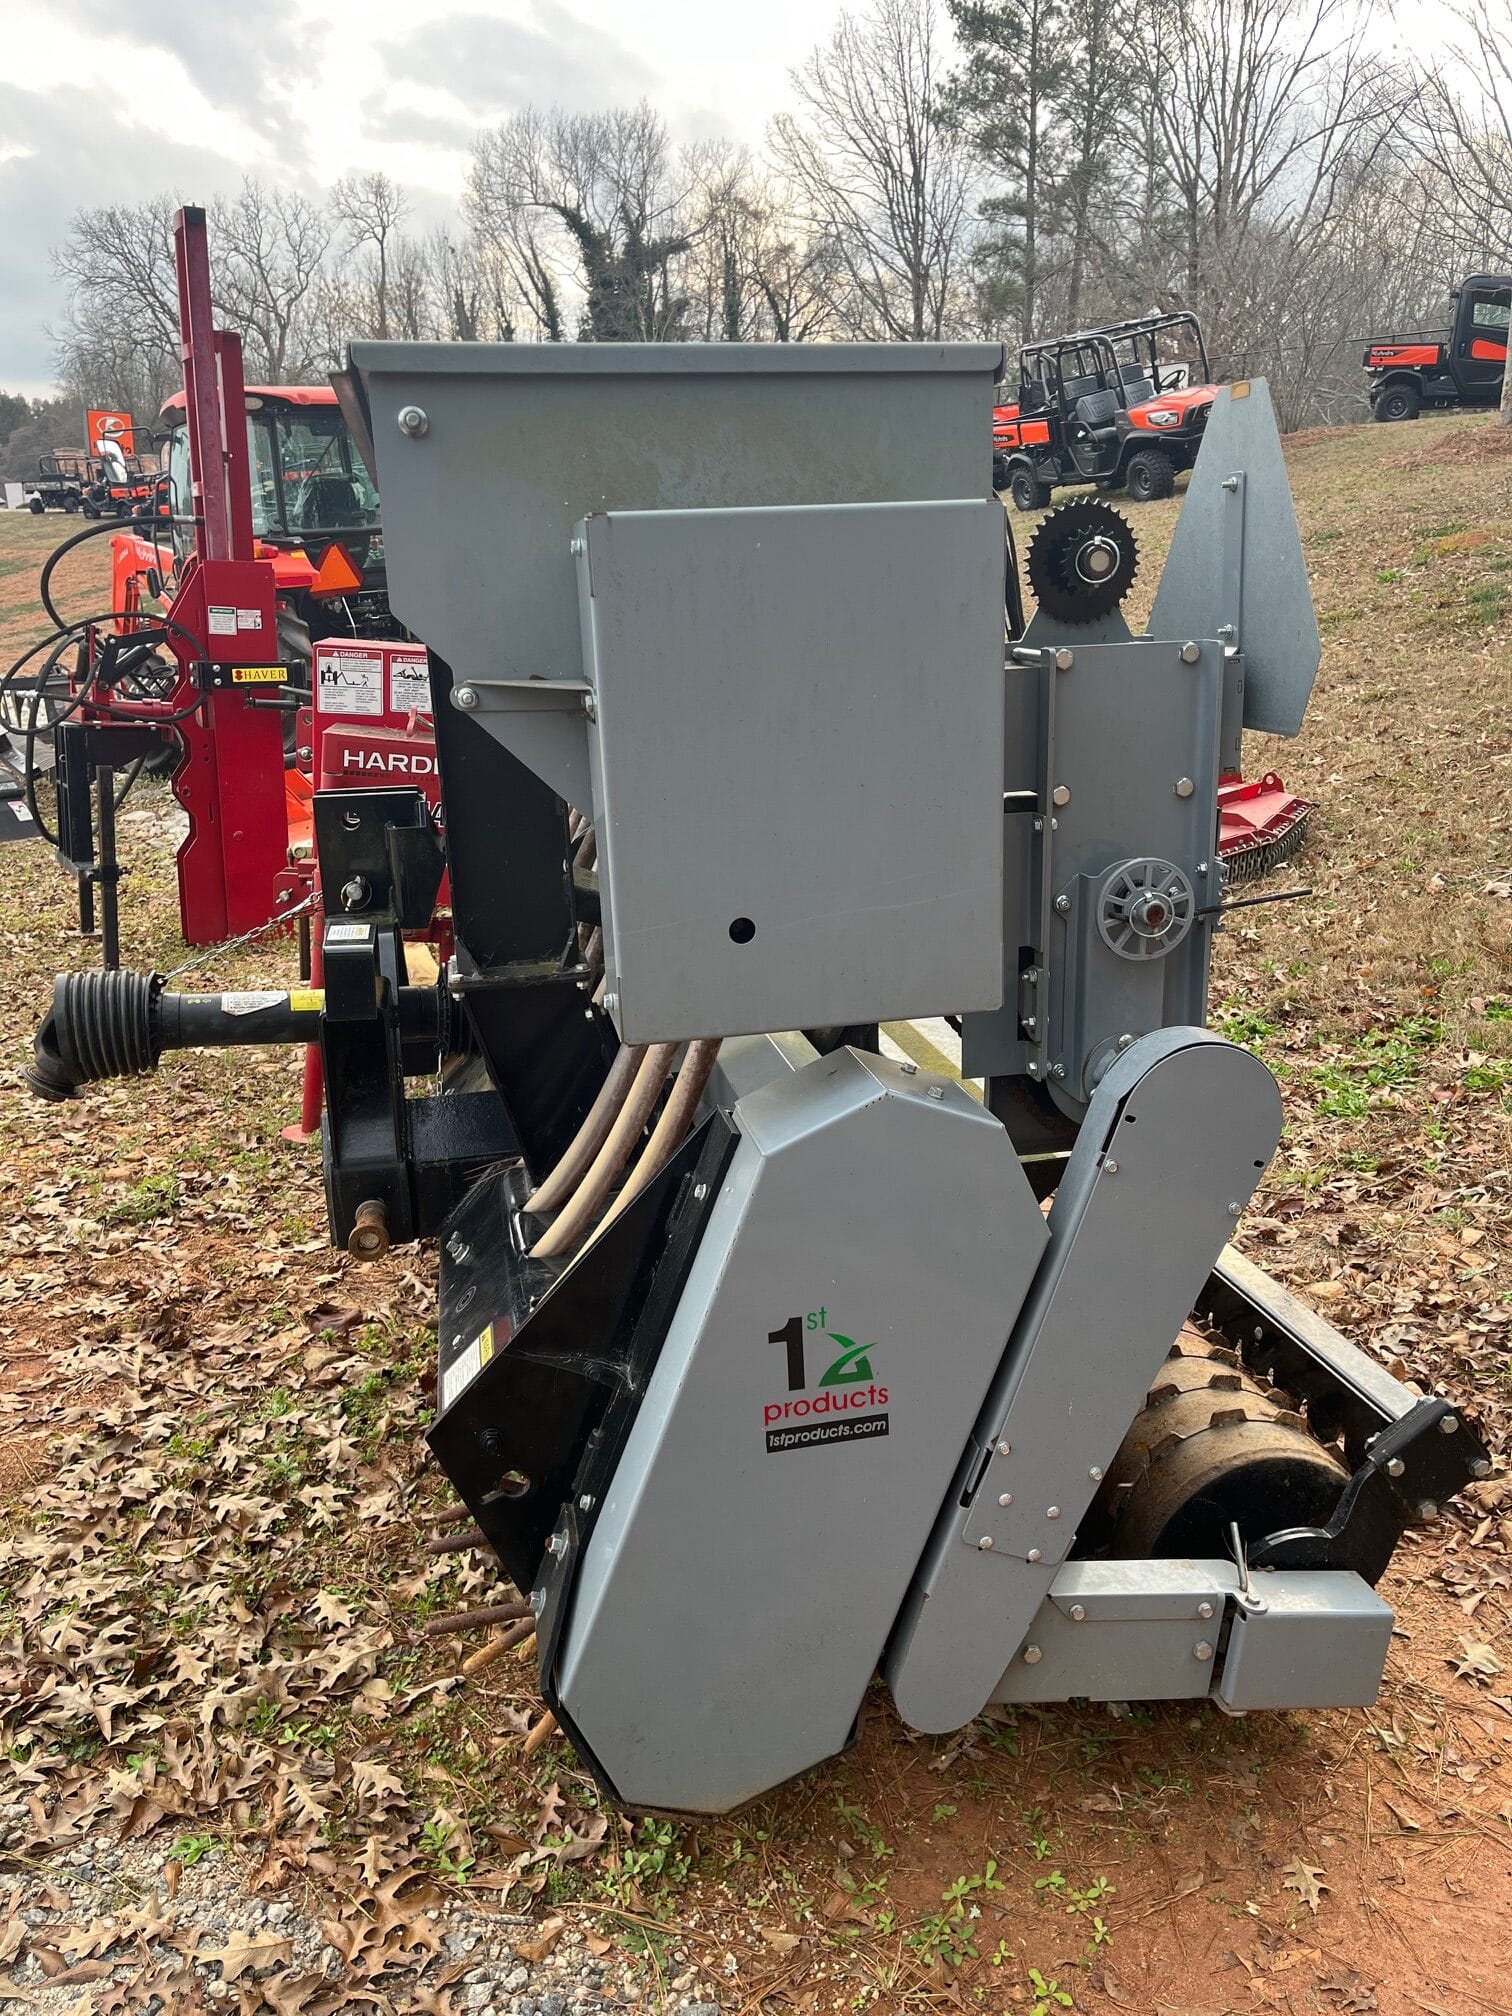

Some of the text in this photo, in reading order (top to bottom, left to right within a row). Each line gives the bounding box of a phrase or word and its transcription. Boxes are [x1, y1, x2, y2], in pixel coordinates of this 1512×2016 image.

[339, 651, 368, 659] DANGER
[768, 1306, 828, 1391] 1st
[764, 1384, 889, 1426] products
[768, 1420, 887, 1447] 1stproducts.com
